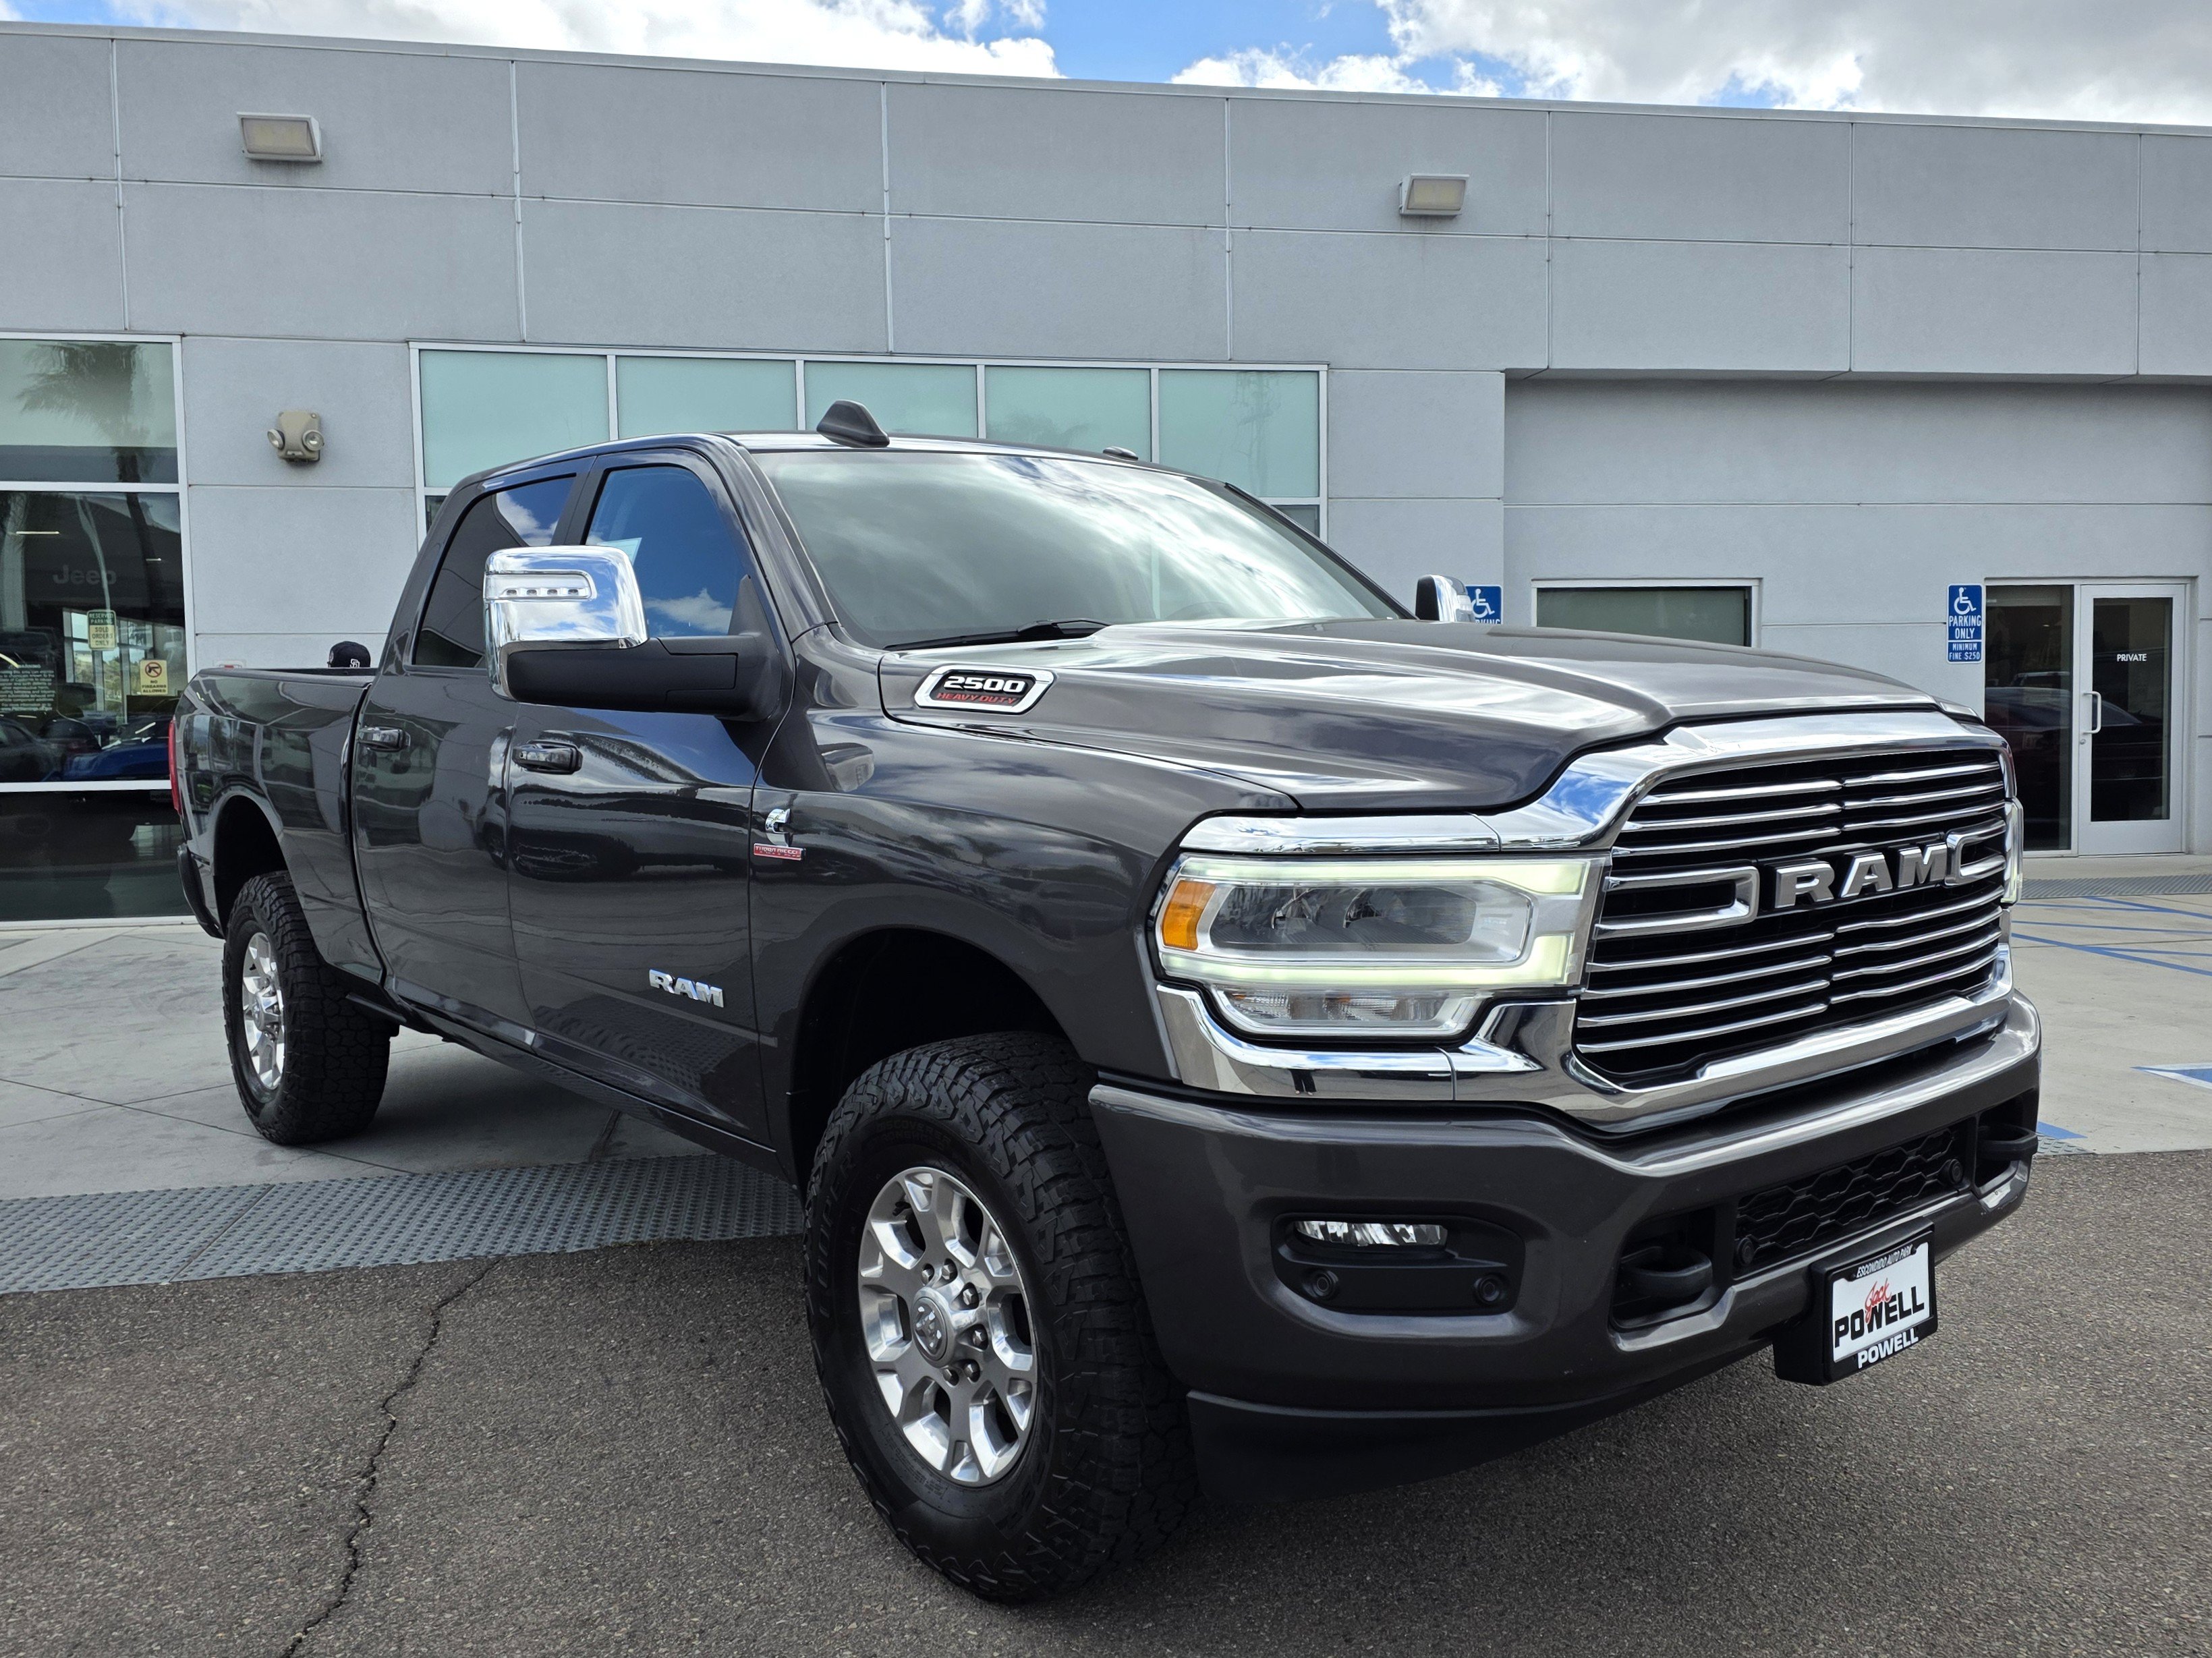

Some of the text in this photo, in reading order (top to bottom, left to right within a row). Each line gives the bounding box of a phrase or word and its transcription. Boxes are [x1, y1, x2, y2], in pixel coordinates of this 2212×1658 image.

[1949, 615, 1981, 627] PARKING
[1955, 627, 1975, 639] ONLY
[1949, 652, 1981, 660] FINE $250
[1952, 643, 1977, 651] MINIMUM
[2117, 653, 2147, 662] PRIVATE
[943, 675, 1027, 693] 2500
[936, 692, 1017, 704] HEAVY DUTY
[1774, 842, 1948, 909] RAM
[649, 969, 725, 1008] RAM
[1856, 1244, 1913, 1278] ESCONDIDO AUTO PARK
[1865, 1277, 1892, 1323] Jack
[1834, 1286, 1925, 1348] POWELL
[1857, 1327, 1919, 1369] POWELL
